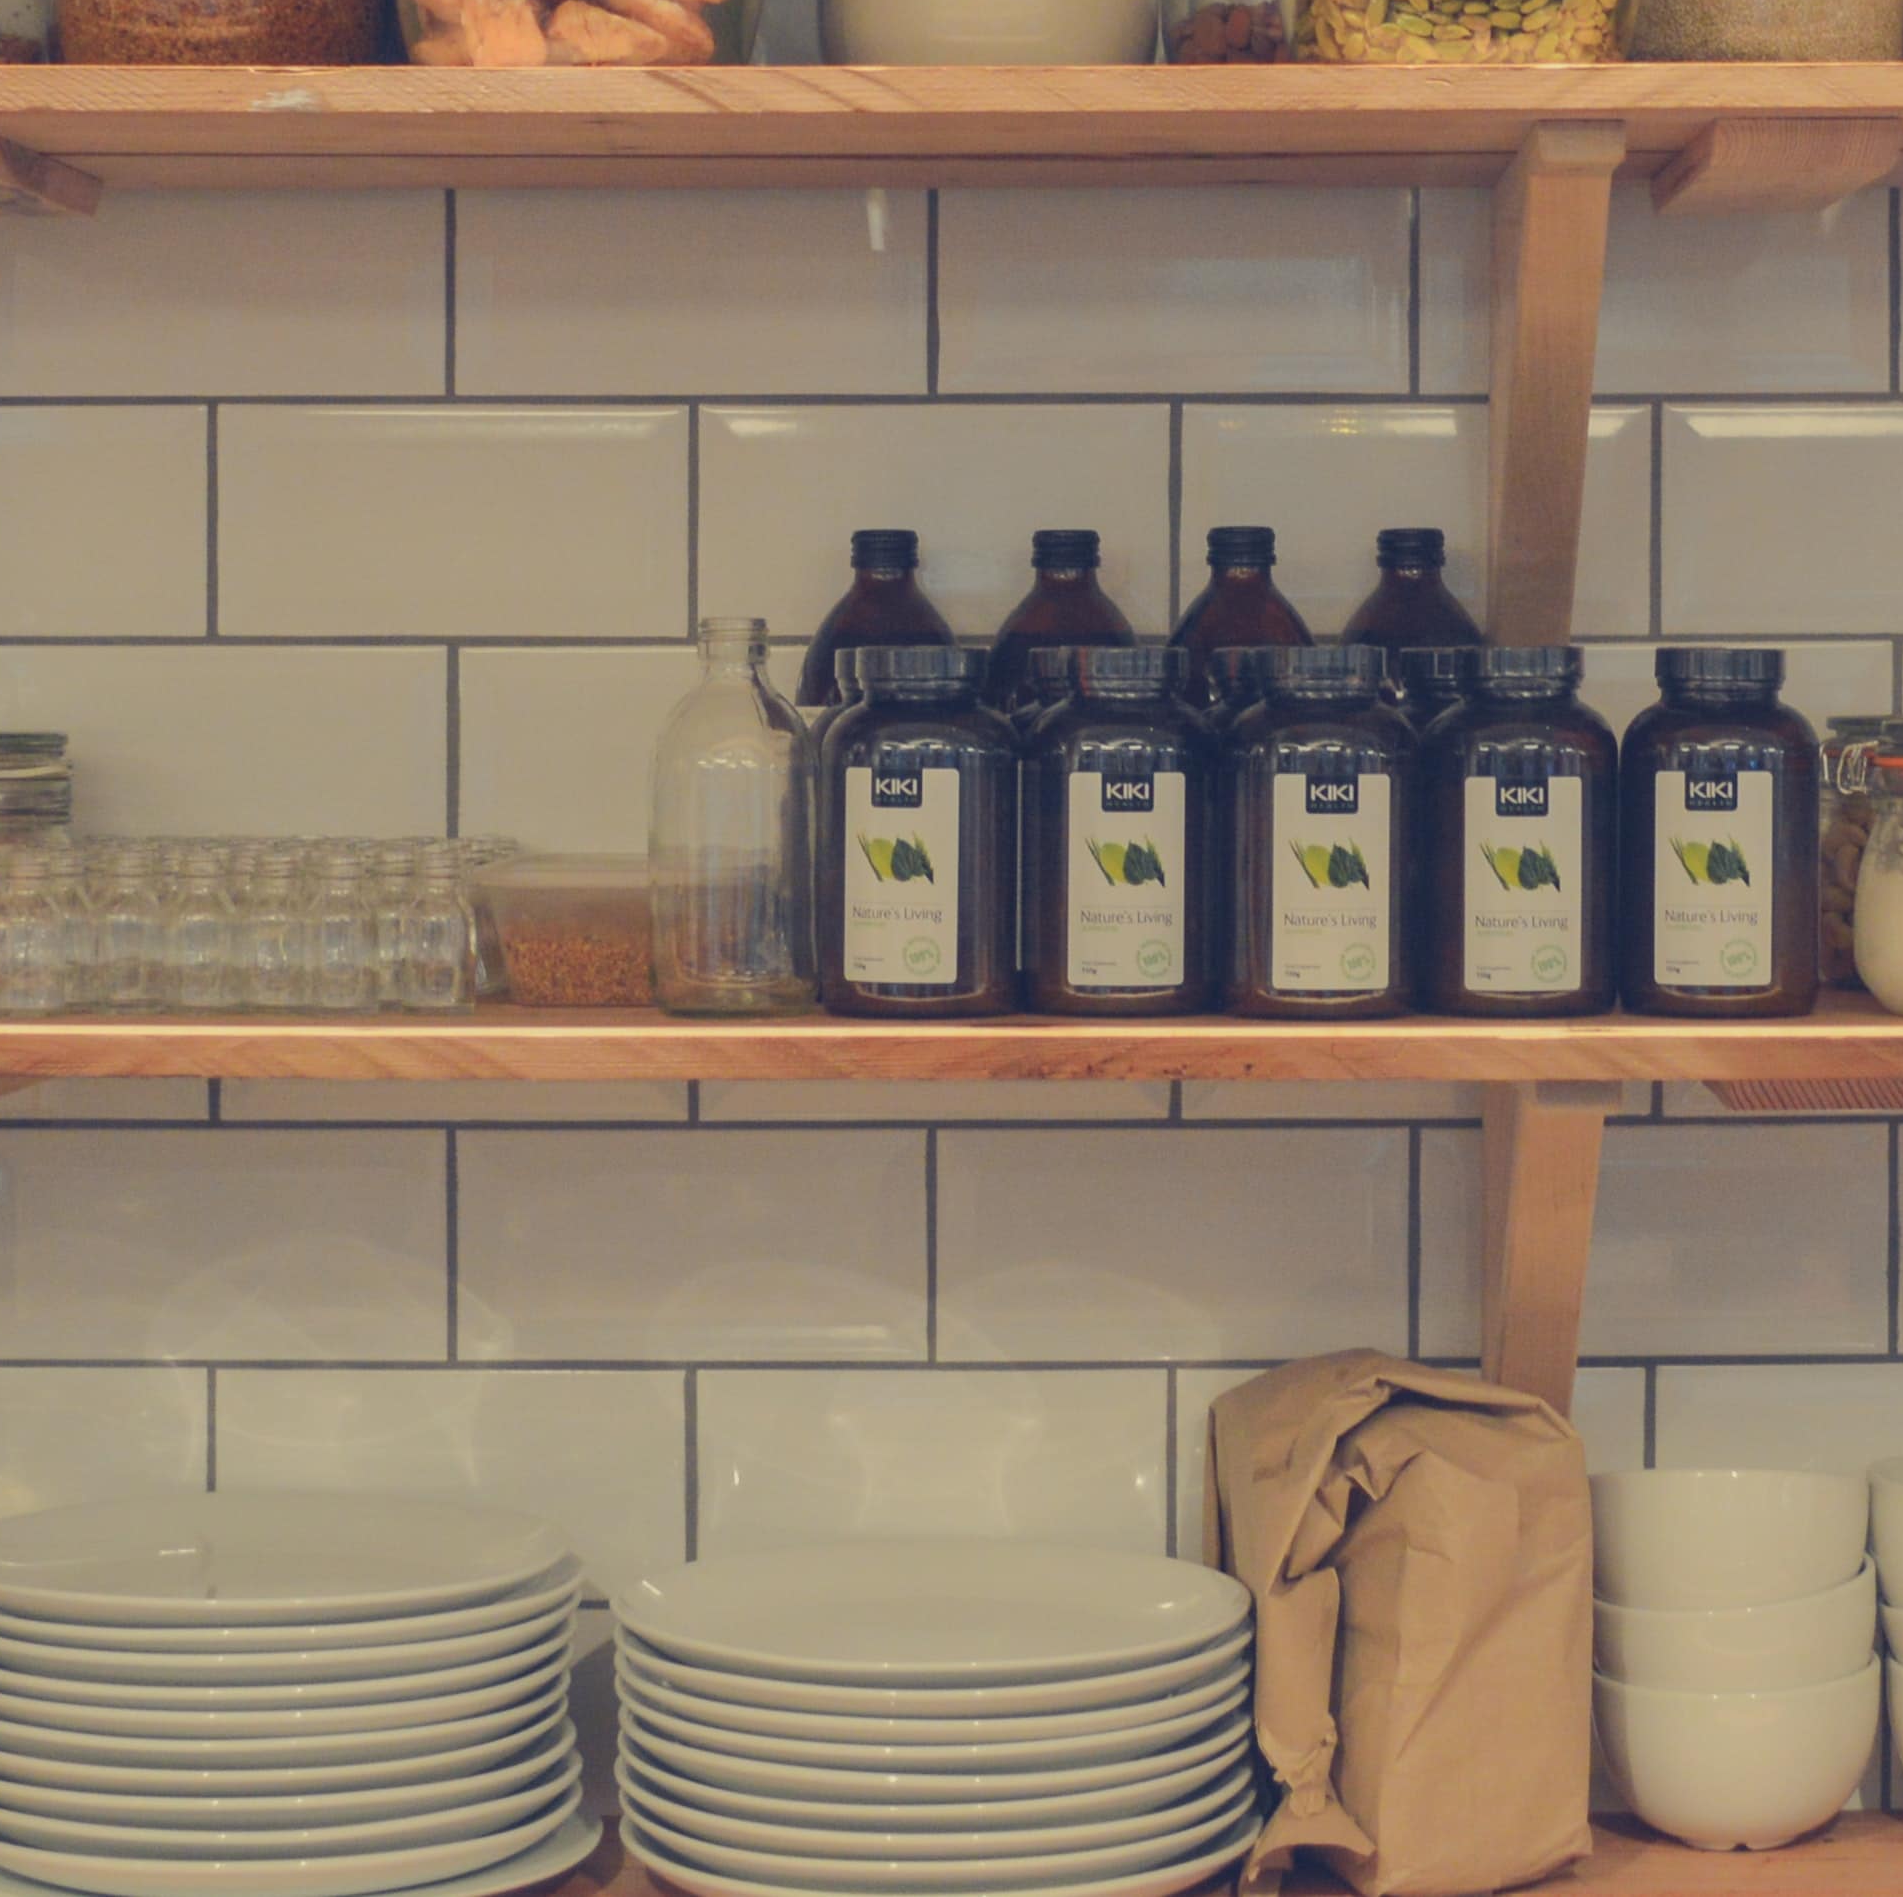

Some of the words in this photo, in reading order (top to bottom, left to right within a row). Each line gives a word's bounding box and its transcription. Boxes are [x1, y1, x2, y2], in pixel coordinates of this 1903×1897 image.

[875, 777, 918, 796] KIKI
[1106, 782, 1150, 801] KIKI
[1310, 784, 1354, 802] KIKI
[1500, 786, 1544, 805] KIKI
[1689, 780, 1733, 799] KIKI
[852, 905, 900, 921] Nature's
[904, 905, 943, 924] Living
[1080, 910, 1133, 925] Nature's
[1137, 910, 1173, 927] Living
[1283, 912, 1337, 928] Nature's
[1340, 912, 1378, 929] Living
[1474, 914, 1529, 929] Nature's
[1531, 914, 1569, 932] Living
[1664, 909, 1716, 924] Nature's
[1719, 909, 1759, 927] Living
